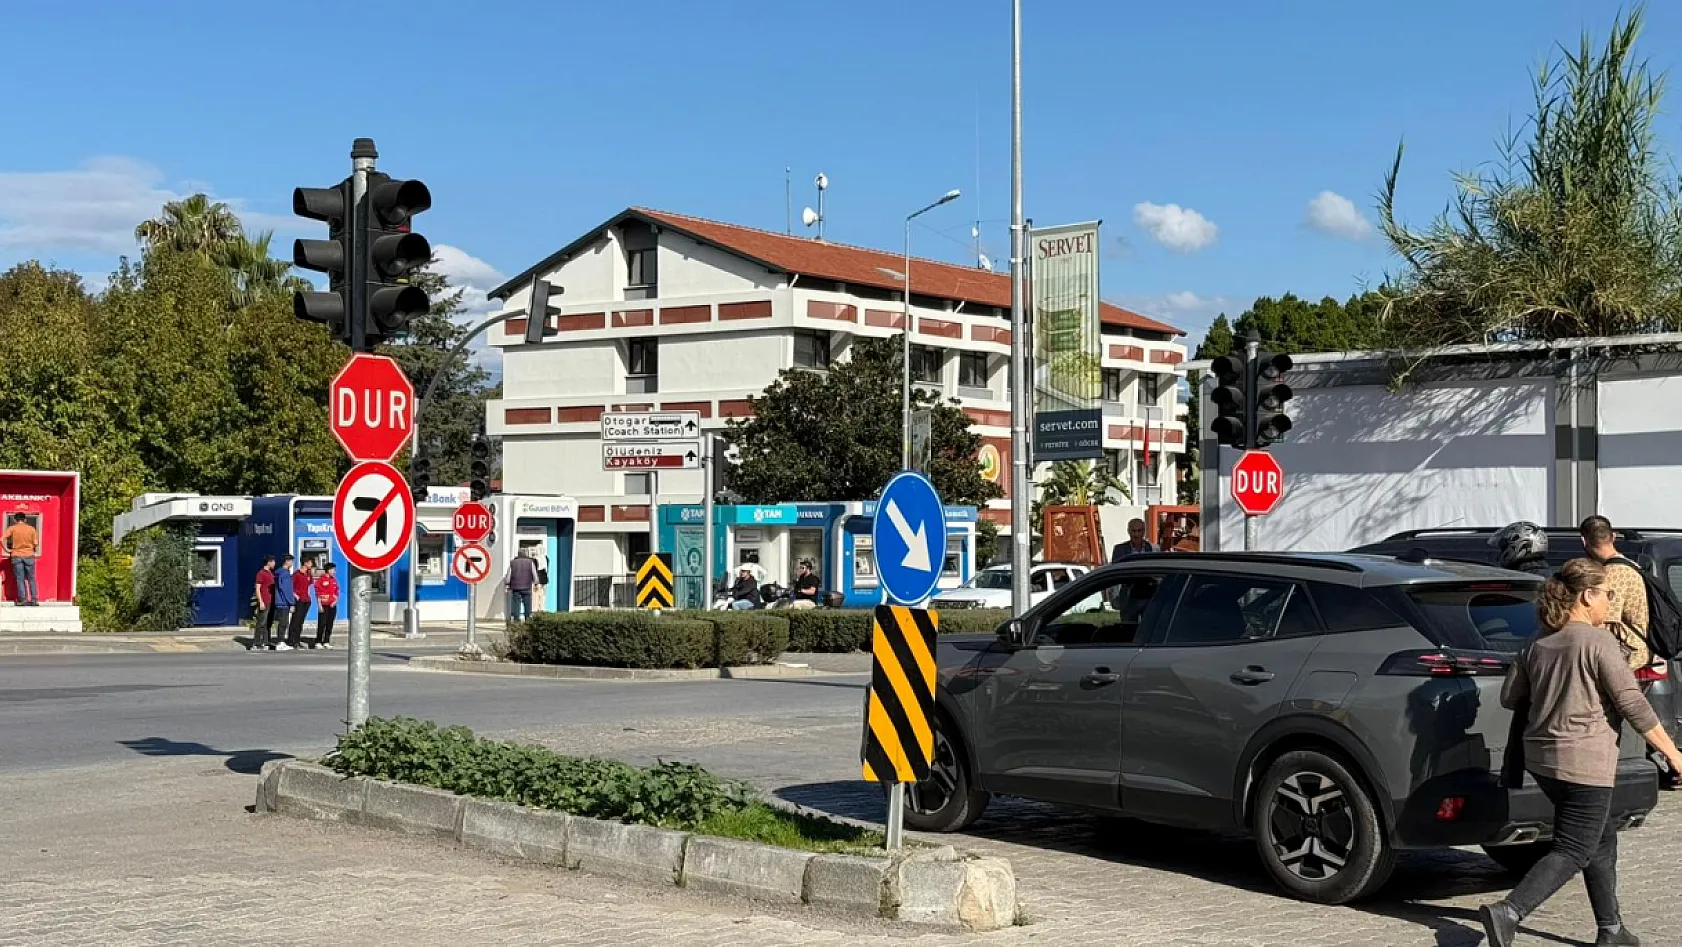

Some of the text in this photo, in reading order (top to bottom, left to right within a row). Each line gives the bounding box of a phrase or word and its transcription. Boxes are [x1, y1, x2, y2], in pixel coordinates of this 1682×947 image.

[1039, 232, 1095, 260] SERVET
[338, 387, 406, 430] DUR
[604, 416, 646, 427] Otogar
[1039, 420, 1099, 432] servet.com
[604, 426, 685, 438] (Coach Station)
[606, 456, 659, 468] Kayaköy
[1237, 469, 1278, 494] DUR
[211, 502, 234, 511] QNB
[455, 514, 488, 529] DUR
